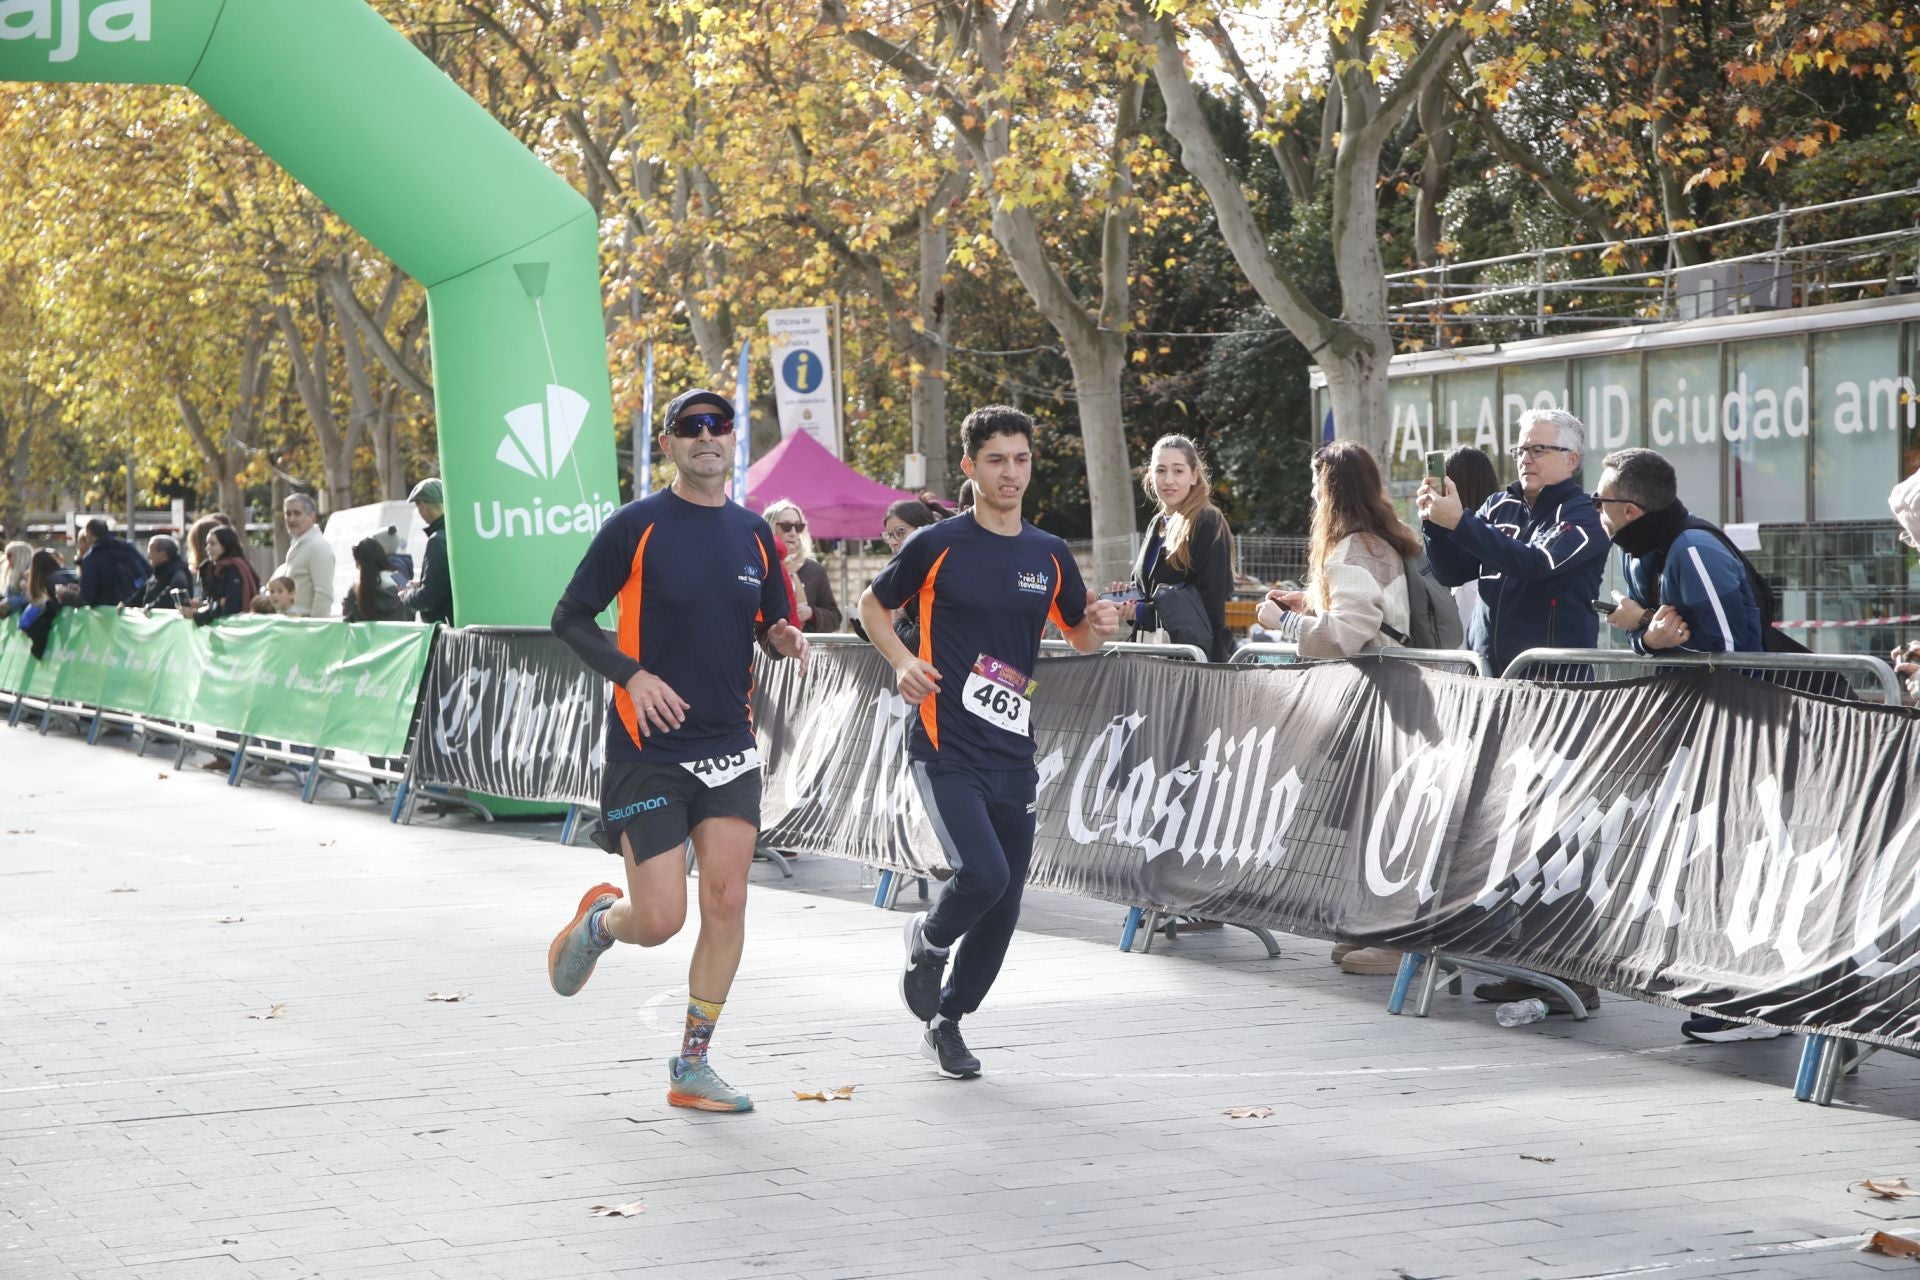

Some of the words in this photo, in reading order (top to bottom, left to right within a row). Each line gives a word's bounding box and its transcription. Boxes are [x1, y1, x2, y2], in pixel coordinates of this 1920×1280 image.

[1652, 366, 1809, 447] ciudad
[973, 683, 1021, 720] 463
[607, 796, 668, 821] salomon
[1067, 709, 1304, 873] Castilla
[1724, 775, 1842, 975] de
